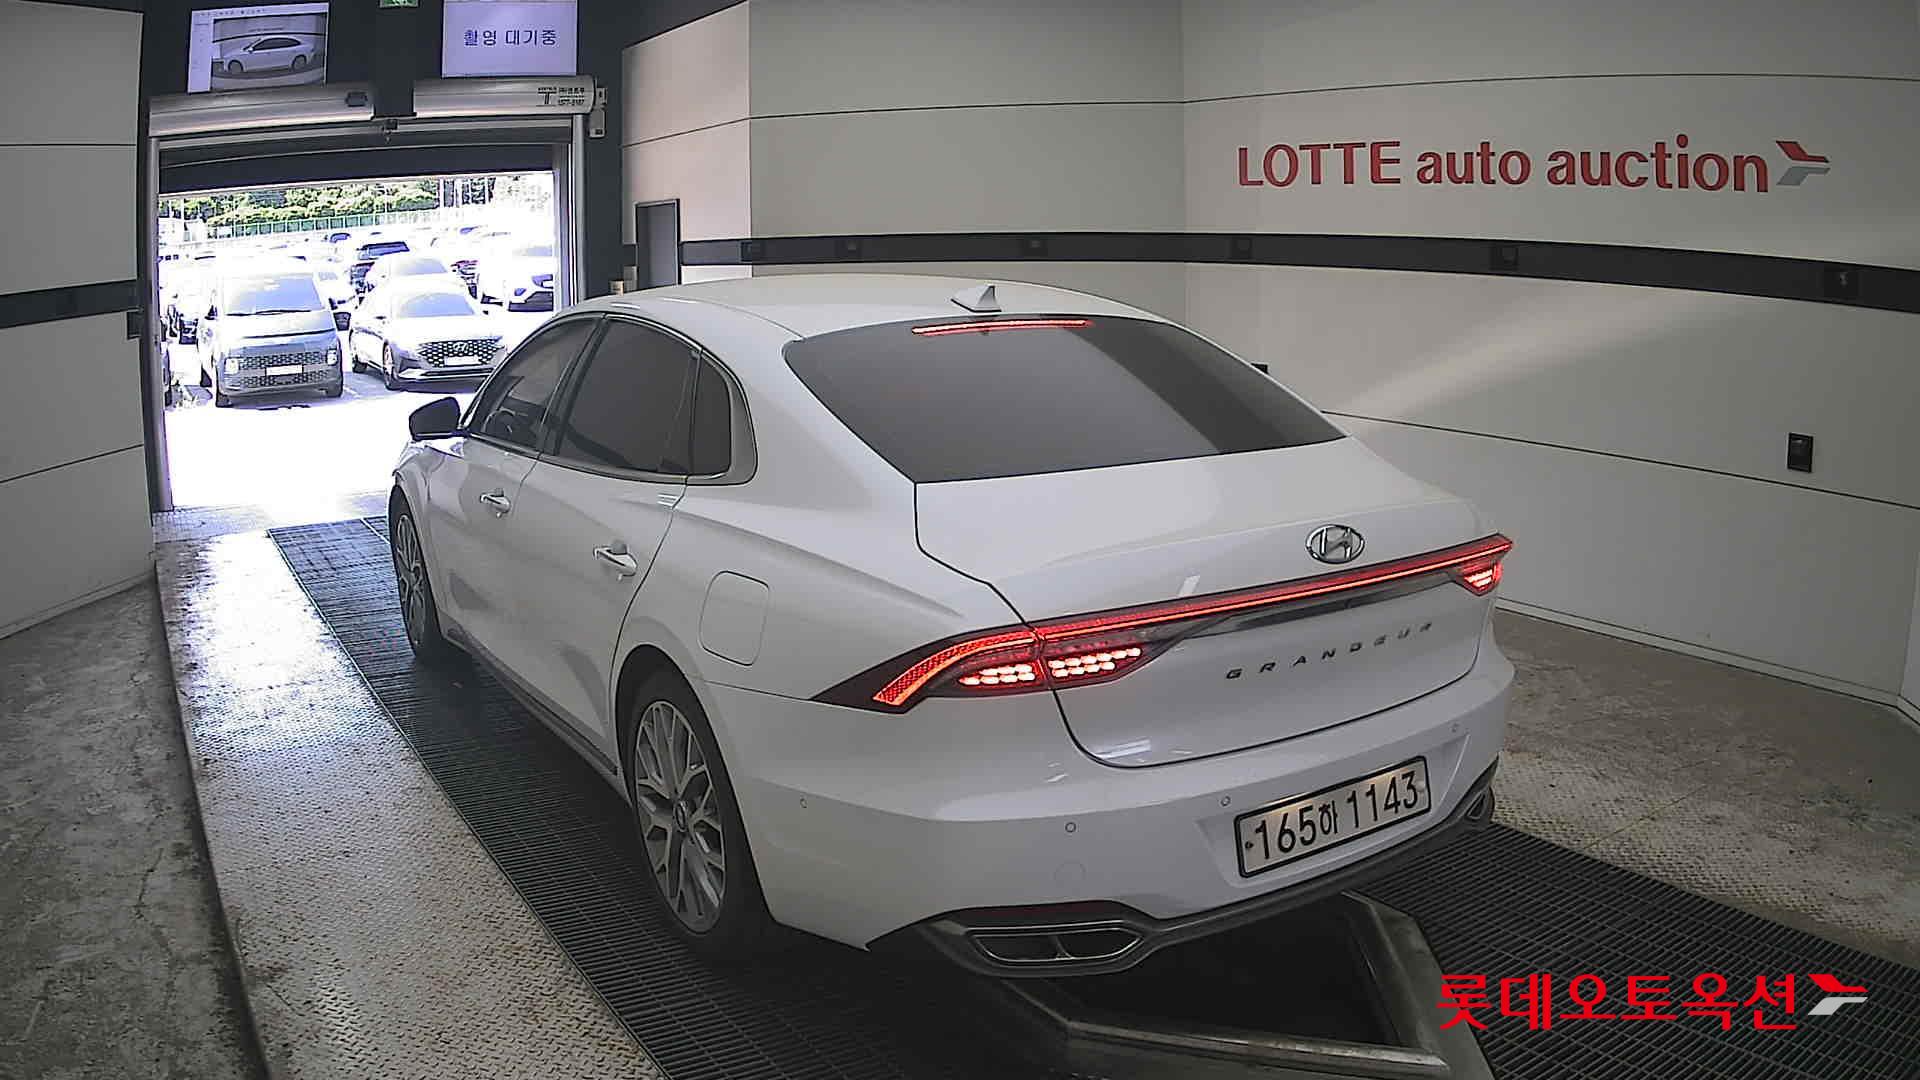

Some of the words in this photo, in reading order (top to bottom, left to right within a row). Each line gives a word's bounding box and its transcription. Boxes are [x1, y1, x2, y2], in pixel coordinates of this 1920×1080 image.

[505, 29, 557, 46] 대기중
[1238, 141, 1400, 187] LOTTE
[1416, 141, 1531, 185] auto
[1546, 134, 1769, 193] auction
[1226, 622, 1432, 679] GRANDEUR
[1255, 801, 1338, 859] 165하
[1347, 770, 1418, 828] 1143
